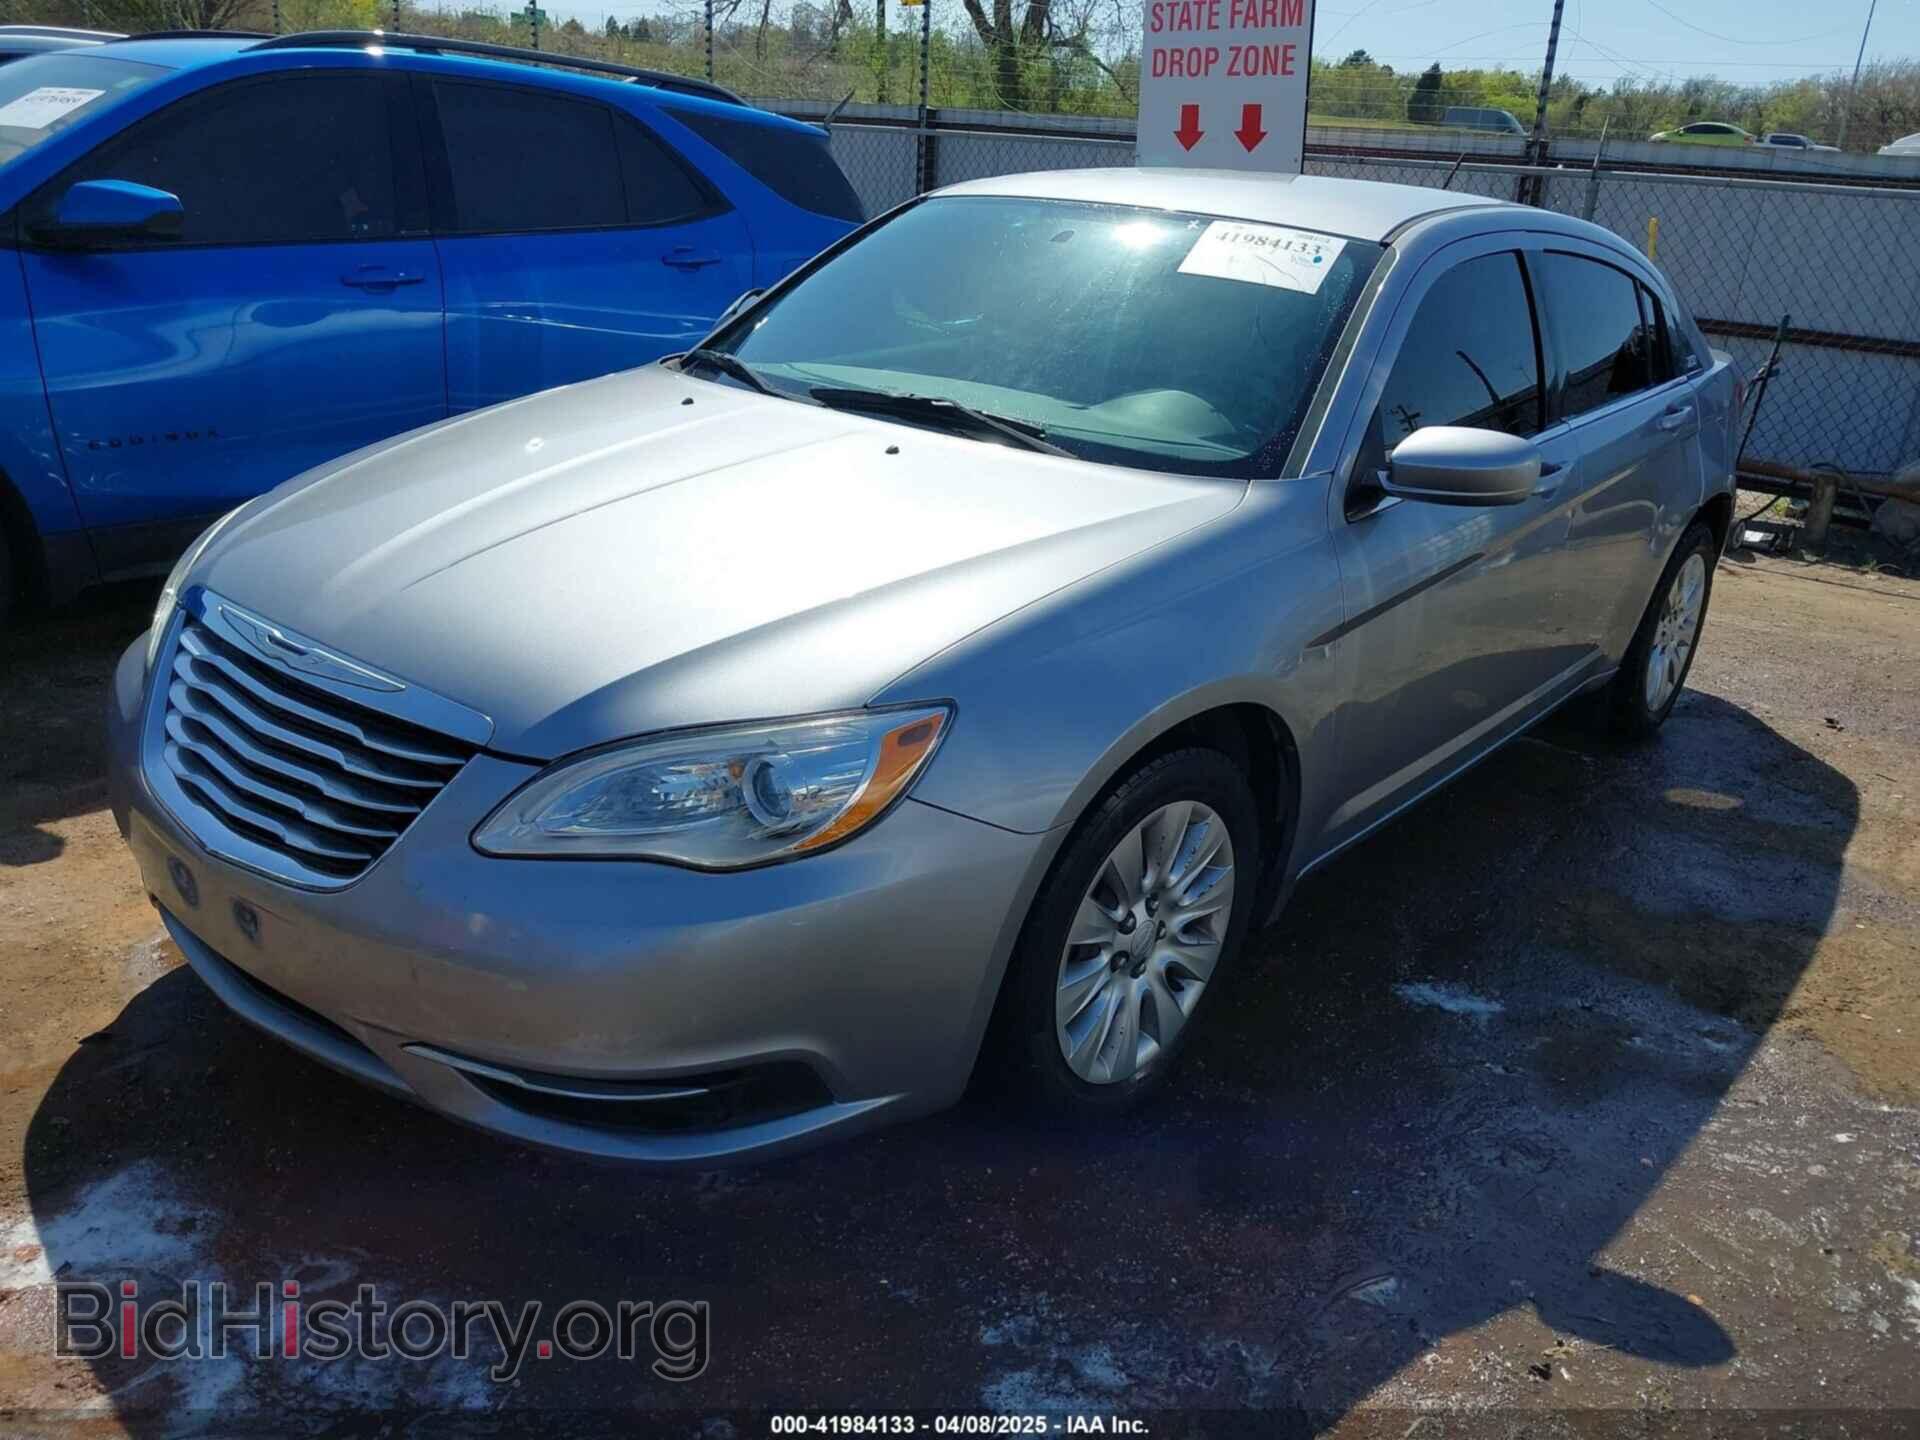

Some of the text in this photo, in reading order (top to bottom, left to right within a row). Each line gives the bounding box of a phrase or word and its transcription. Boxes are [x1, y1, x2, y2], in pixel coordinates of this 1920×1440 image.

[1151, 0, 1304, 32] STATE FARM
[1152, 45, 1296, 78] DROP ZONE
